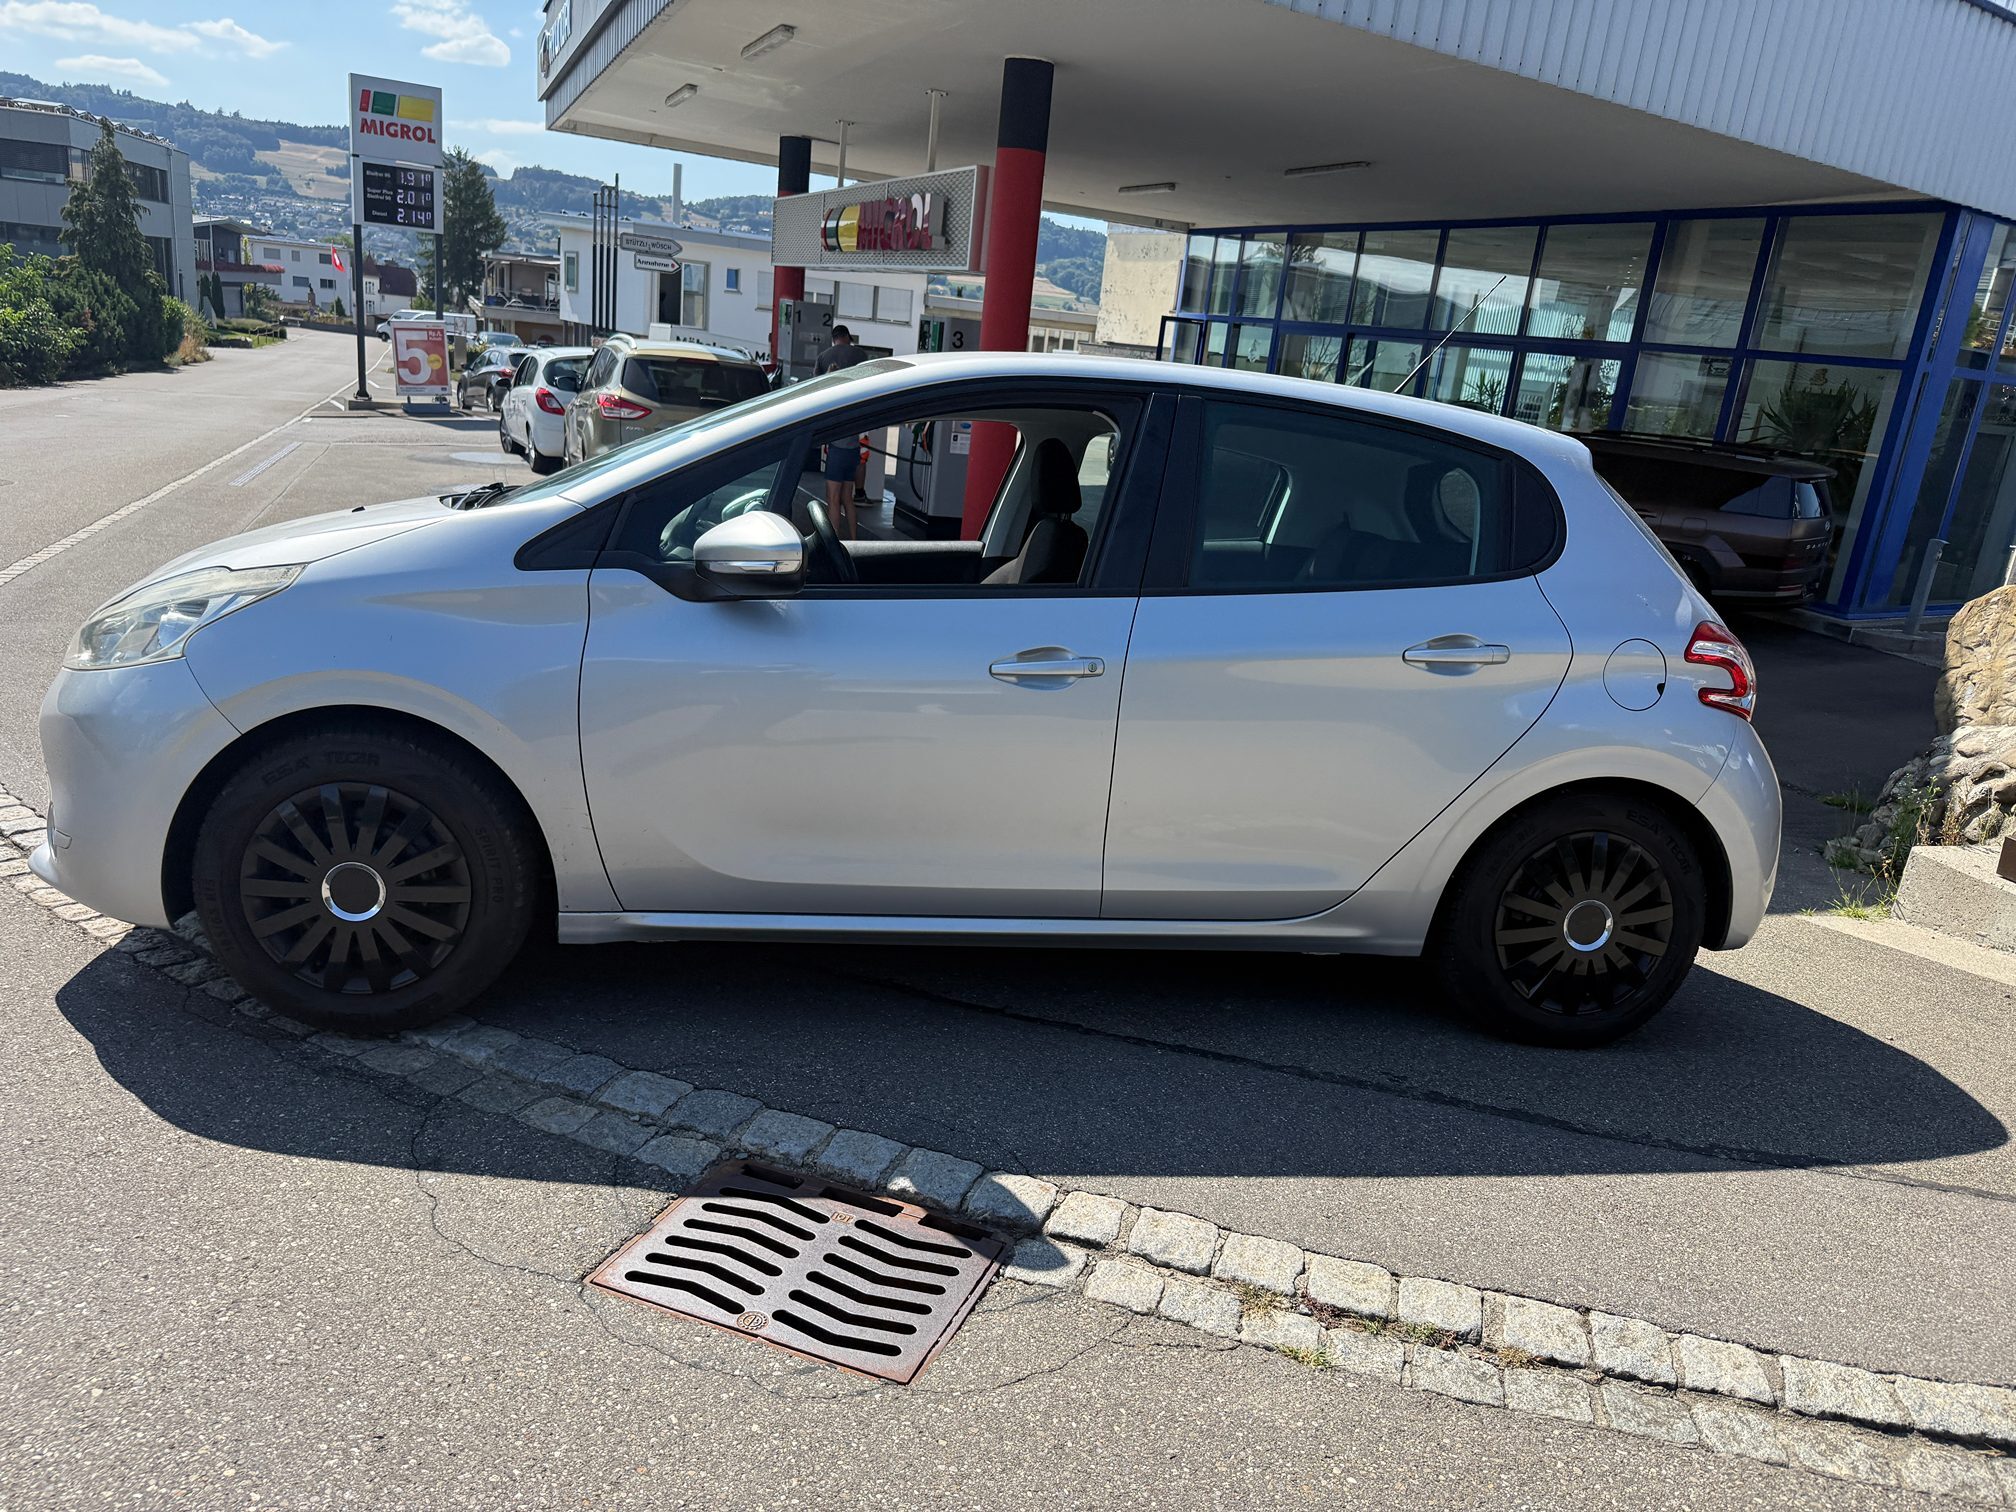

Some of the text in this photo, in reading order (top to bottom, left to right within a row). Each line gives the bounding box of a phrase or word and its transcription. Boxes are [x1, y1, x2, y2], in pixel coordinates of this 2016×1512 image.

[360, 118, 436, 144] MIGROL
[650, 241, 672, 251] WÖSCH
[637, 258, 670, 268] Annahme
[795, 309, 802, 324] 1
[822, 312, 832, 327] 2
[952, 330, 964, 349] 3
[395, 330, 432, 384] 5
